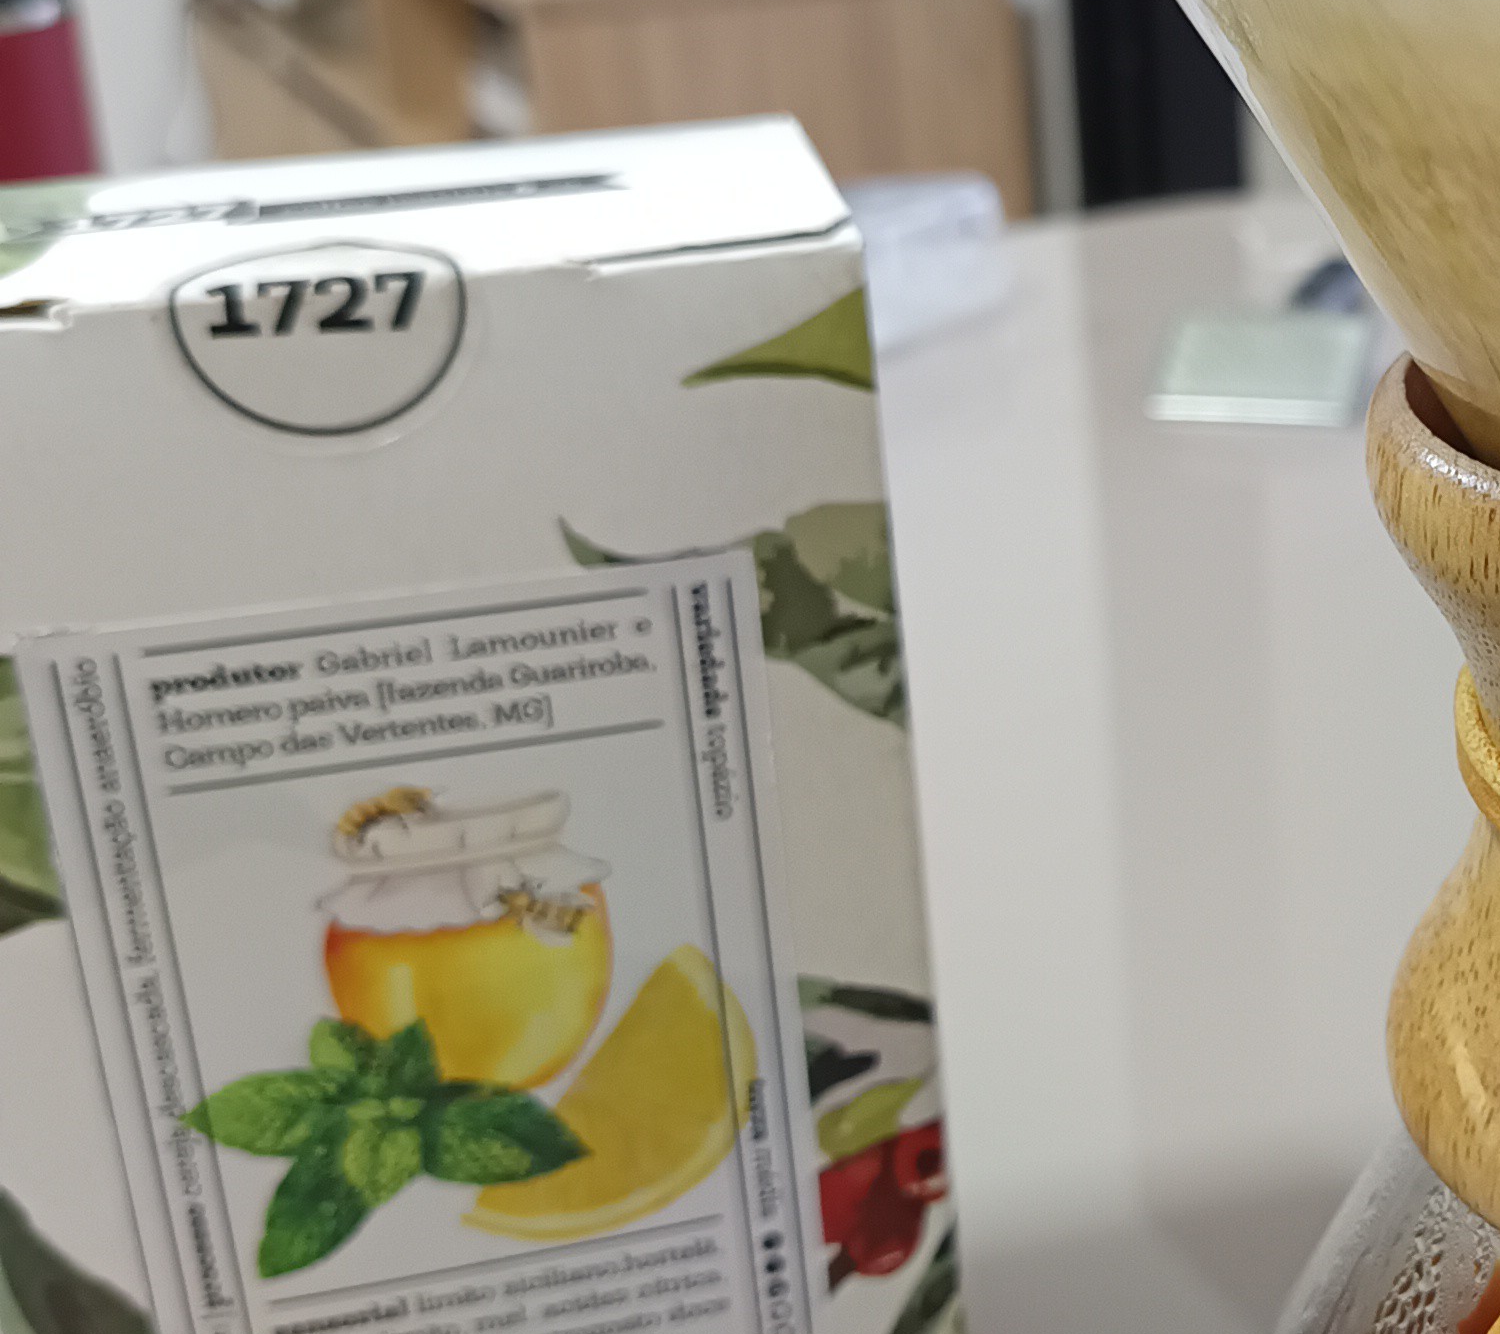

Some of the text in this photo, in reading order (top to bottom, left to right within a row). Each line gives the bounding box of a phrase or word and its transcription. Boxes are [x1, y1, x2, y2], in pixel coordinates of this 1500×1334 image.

[207, 270, 426, 338] 1727
[150, 617, 655, 703] produtor Gabriel Lamounier e
[691, 581, 729, 718] variedade
[156, 701, 284, 734] Homero
[288, 687, 371, 724] paiva
[164, 738, 275, 769] Campo
[280, 727, 334, 754] das
[490, 691, 554, 729] MG]
